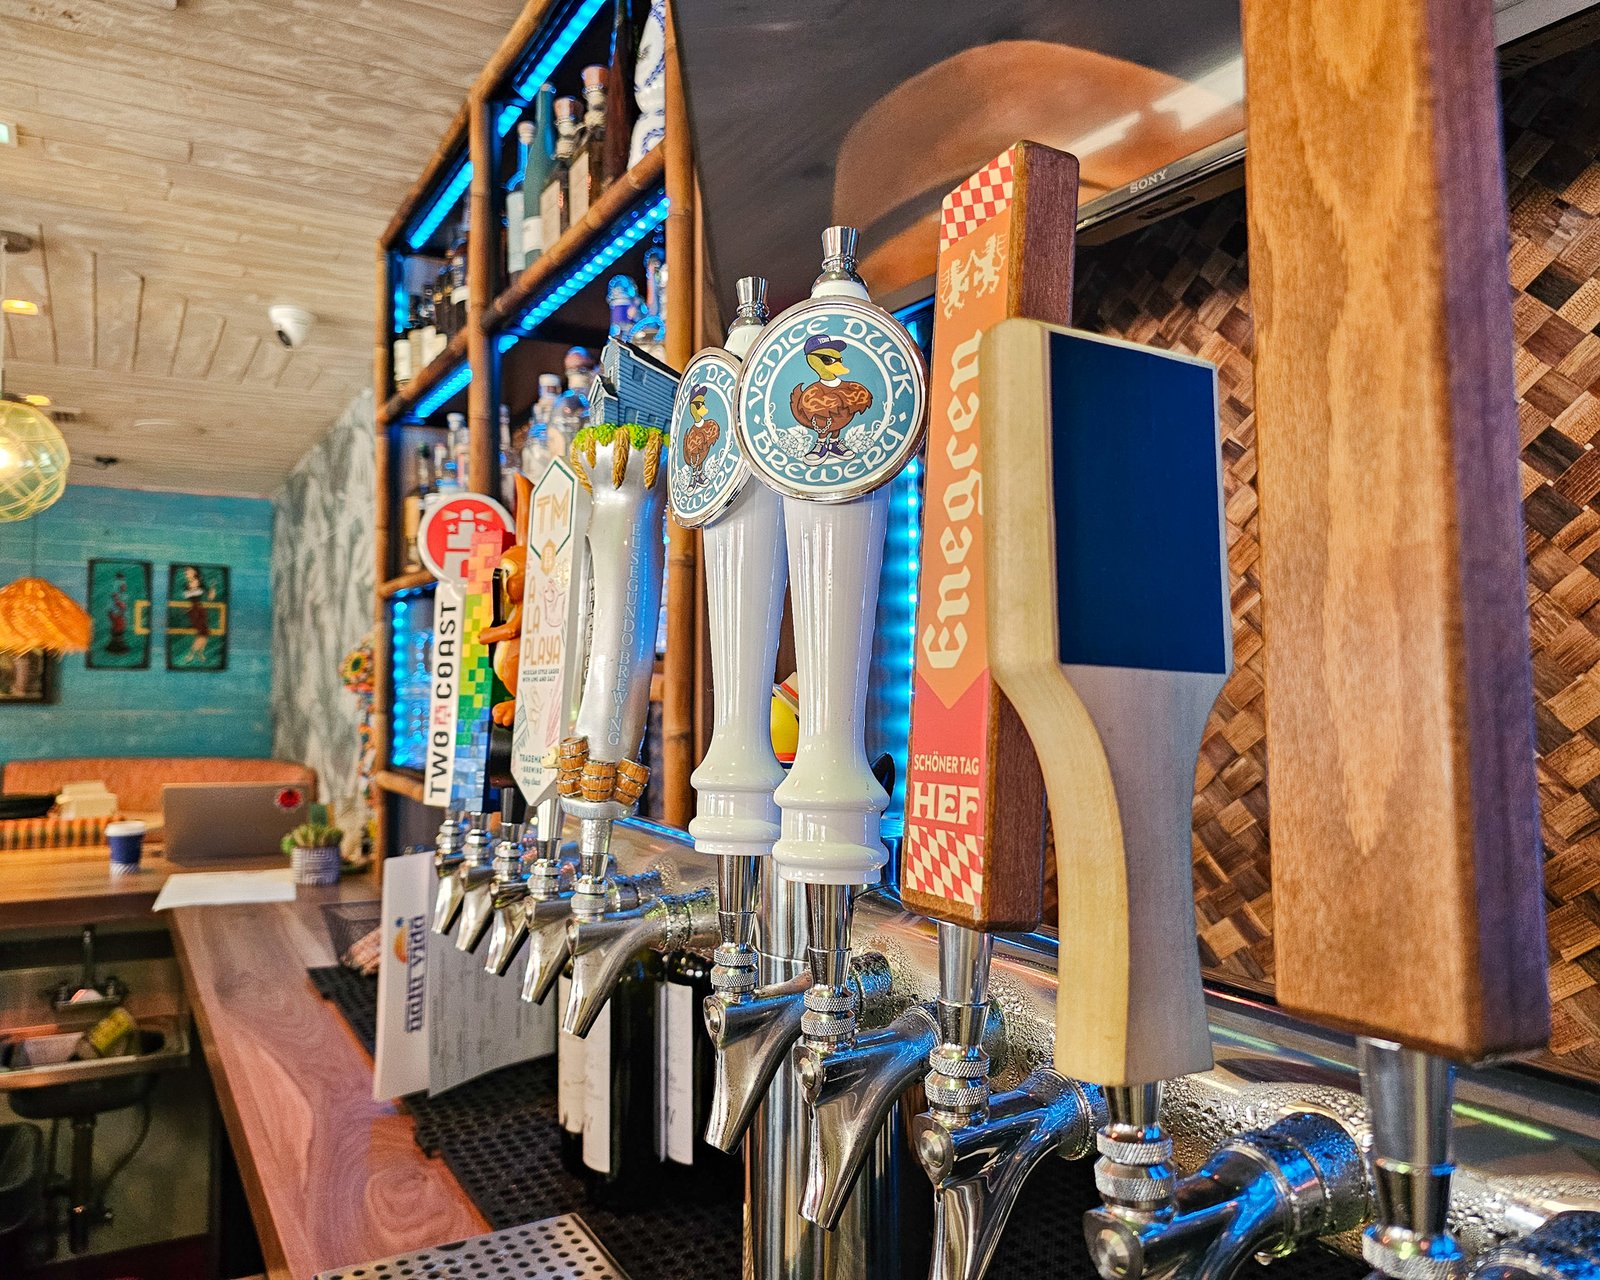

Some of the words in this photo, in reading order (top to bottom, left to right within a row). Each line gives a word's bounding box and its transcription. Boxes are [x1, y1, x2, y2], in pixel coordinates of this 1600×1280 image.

[1129, 168, 1168, 193] SONY
[706, 364, 736, 403] DUC
[748, 316, 829, 410] VENICE
[844, 318, 913, 400] DUCK
[753, 427, 904, 482] BREWERY
[536, 488, 569, 535] TM
[922, 328, 983, 669] Enegren
[631, 523, 641, 549] EL
[525, 605, 540, 635] LA
[621, 552, 639, 646] SEGUNDO
[436, 602, 457, 699] COAST
[523, 635, 561, 667] PLAYA
[607, 651, 630, 745] BREWING
[429, 732, 449, 798] TWO
[913, 751, 958, 774] SCHÖNER
[959, 755, 979, 776] TAG
[912, 781, 980, 825] HEF
[408, 914, 425, 968] vida
